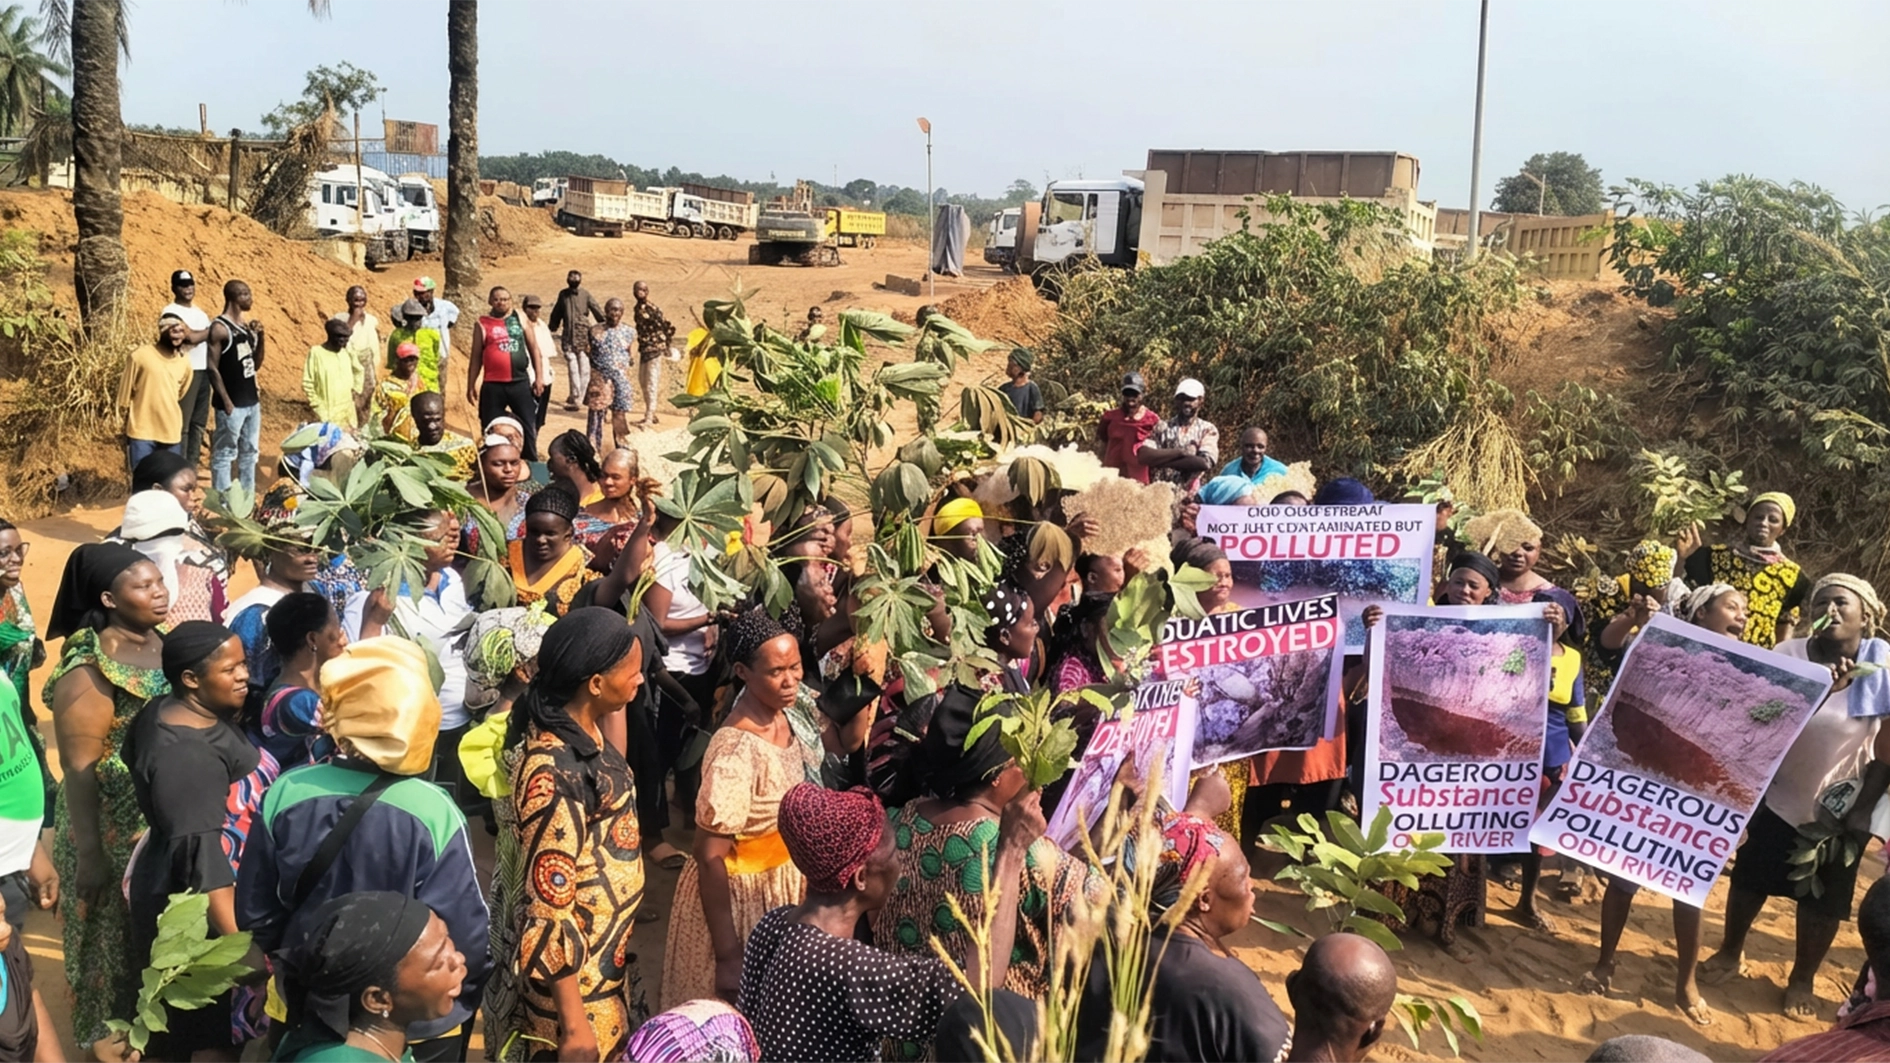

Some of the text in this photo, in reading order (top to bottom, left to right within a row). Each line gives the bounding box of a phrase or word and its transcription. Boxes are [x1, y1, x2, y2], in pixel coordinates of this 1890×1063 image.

[1394, 520, 1423, 532] BUT
[1219, 533, 1402, 559] POLLUTED
[1162, 597, 1334, 644] QUATIC LIVES
[1162, 620, 1335, 674] ESTROYED
[1378, 762, 1539, 783] DAGEROUS
[1379, 782, 1534, 807] Substance
[1571, 760, 1746, 835] DAGEROUS
[1393, 811, 1530, 831] OLLUTING
[1560, 782, 1731, 859] Substance
[1451, 831, 1515, 847] RIVER
[1548, 807, 1719, 883] POLLUTING
[1558, 832, 1695, 896] ODU RIVER
